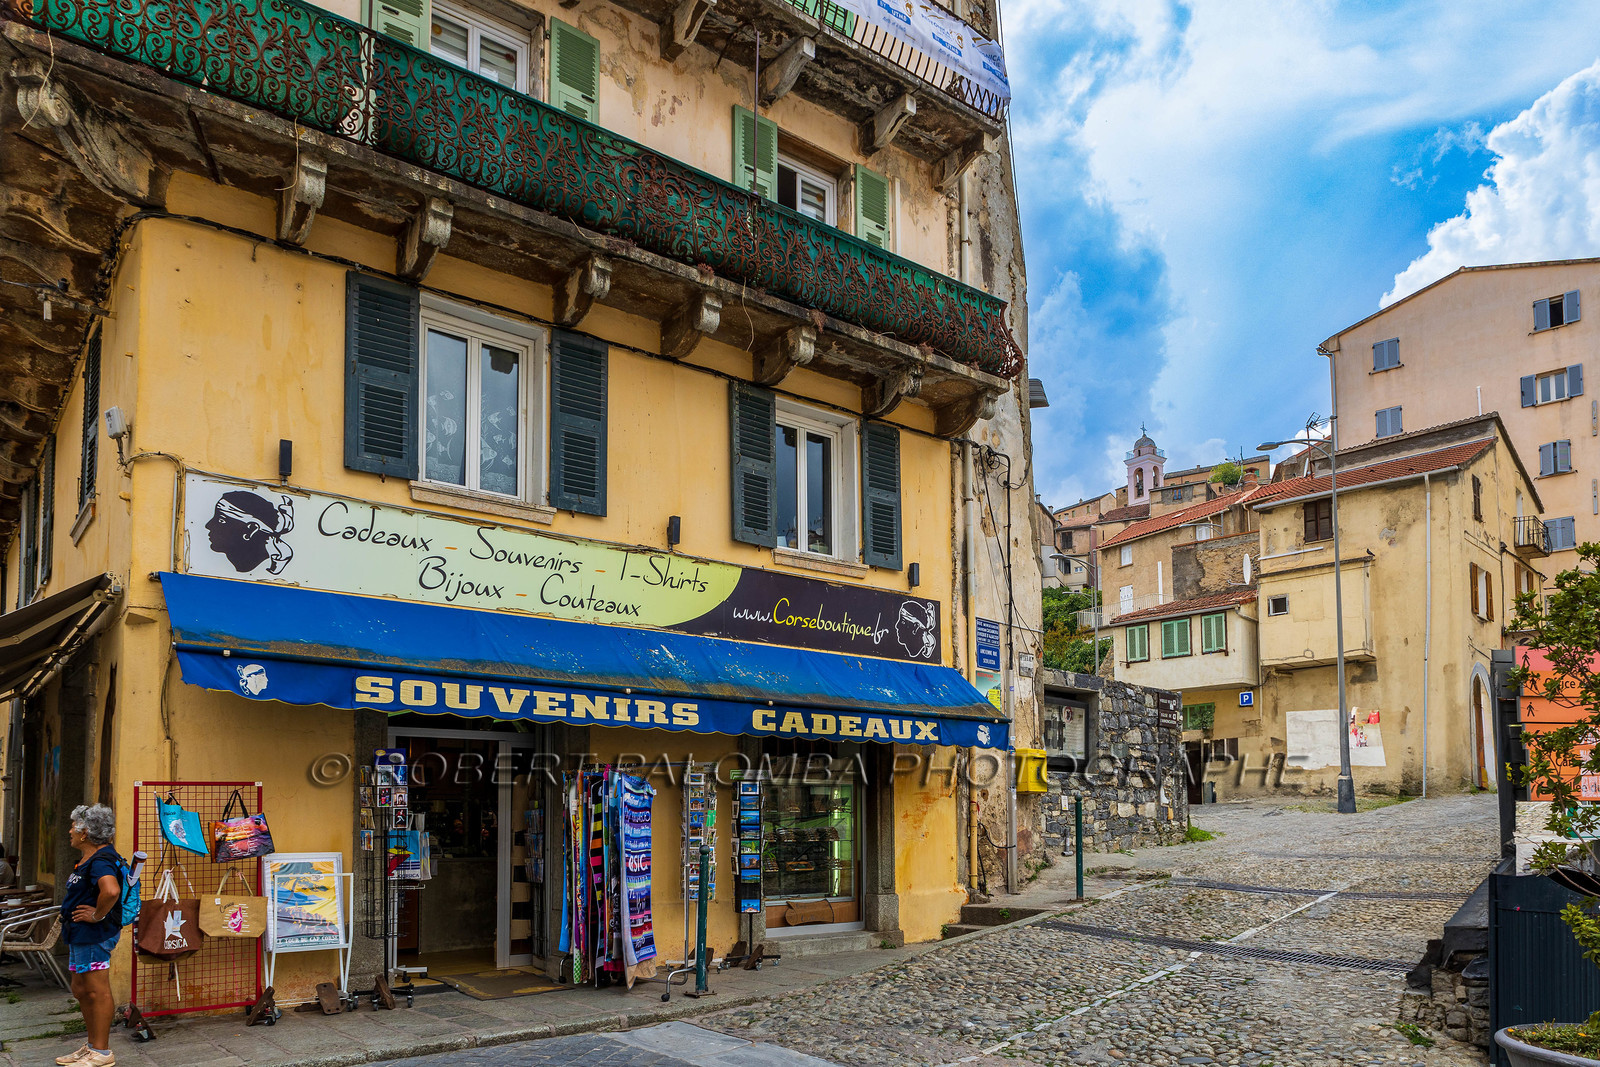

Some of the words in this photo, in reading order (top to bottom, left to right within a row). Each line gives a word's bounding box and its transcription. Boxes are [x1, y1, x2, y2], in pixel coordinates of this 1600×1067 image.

[317, 501, 433, 551] Cadeaux
[470, 526, 583, 573] Souvenirs
[418, 555, 504, 602] Bijoux
[540, 573, 642, 617] Couteaux
[733, 597, 889, 645] www.Corseboutique.fr
[355, 675, 700, 726] SOUVENIRS
[752, 709, 939, 741] CADEAUX
